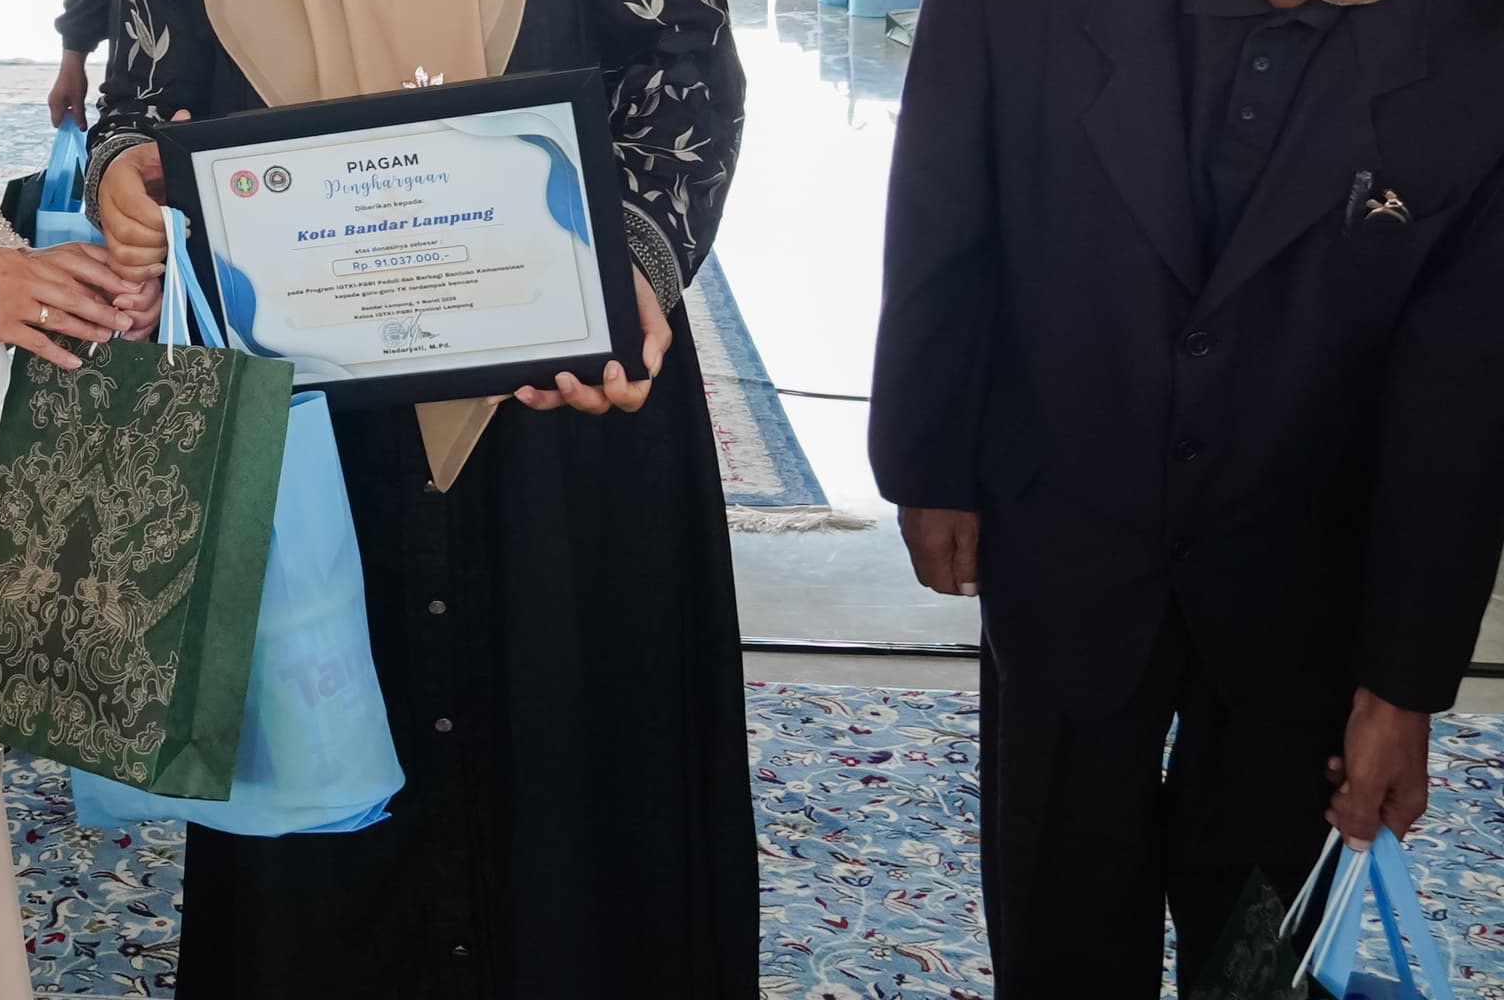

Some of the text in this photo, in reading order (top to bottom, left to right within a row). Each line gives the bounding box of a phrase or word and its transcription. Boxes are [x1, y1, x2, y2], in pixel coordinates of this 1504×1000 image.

[346, 153, 420, 174] PIAGAM
[324, 170, 451, 200] Penghargaan
[354, 202, 392, 212] Diberikan
[296, 207, 495, 242] Kota Bandar Lampung
[352, 261, 372, 272] Rp.
[306, 286, 335, 294] Program
